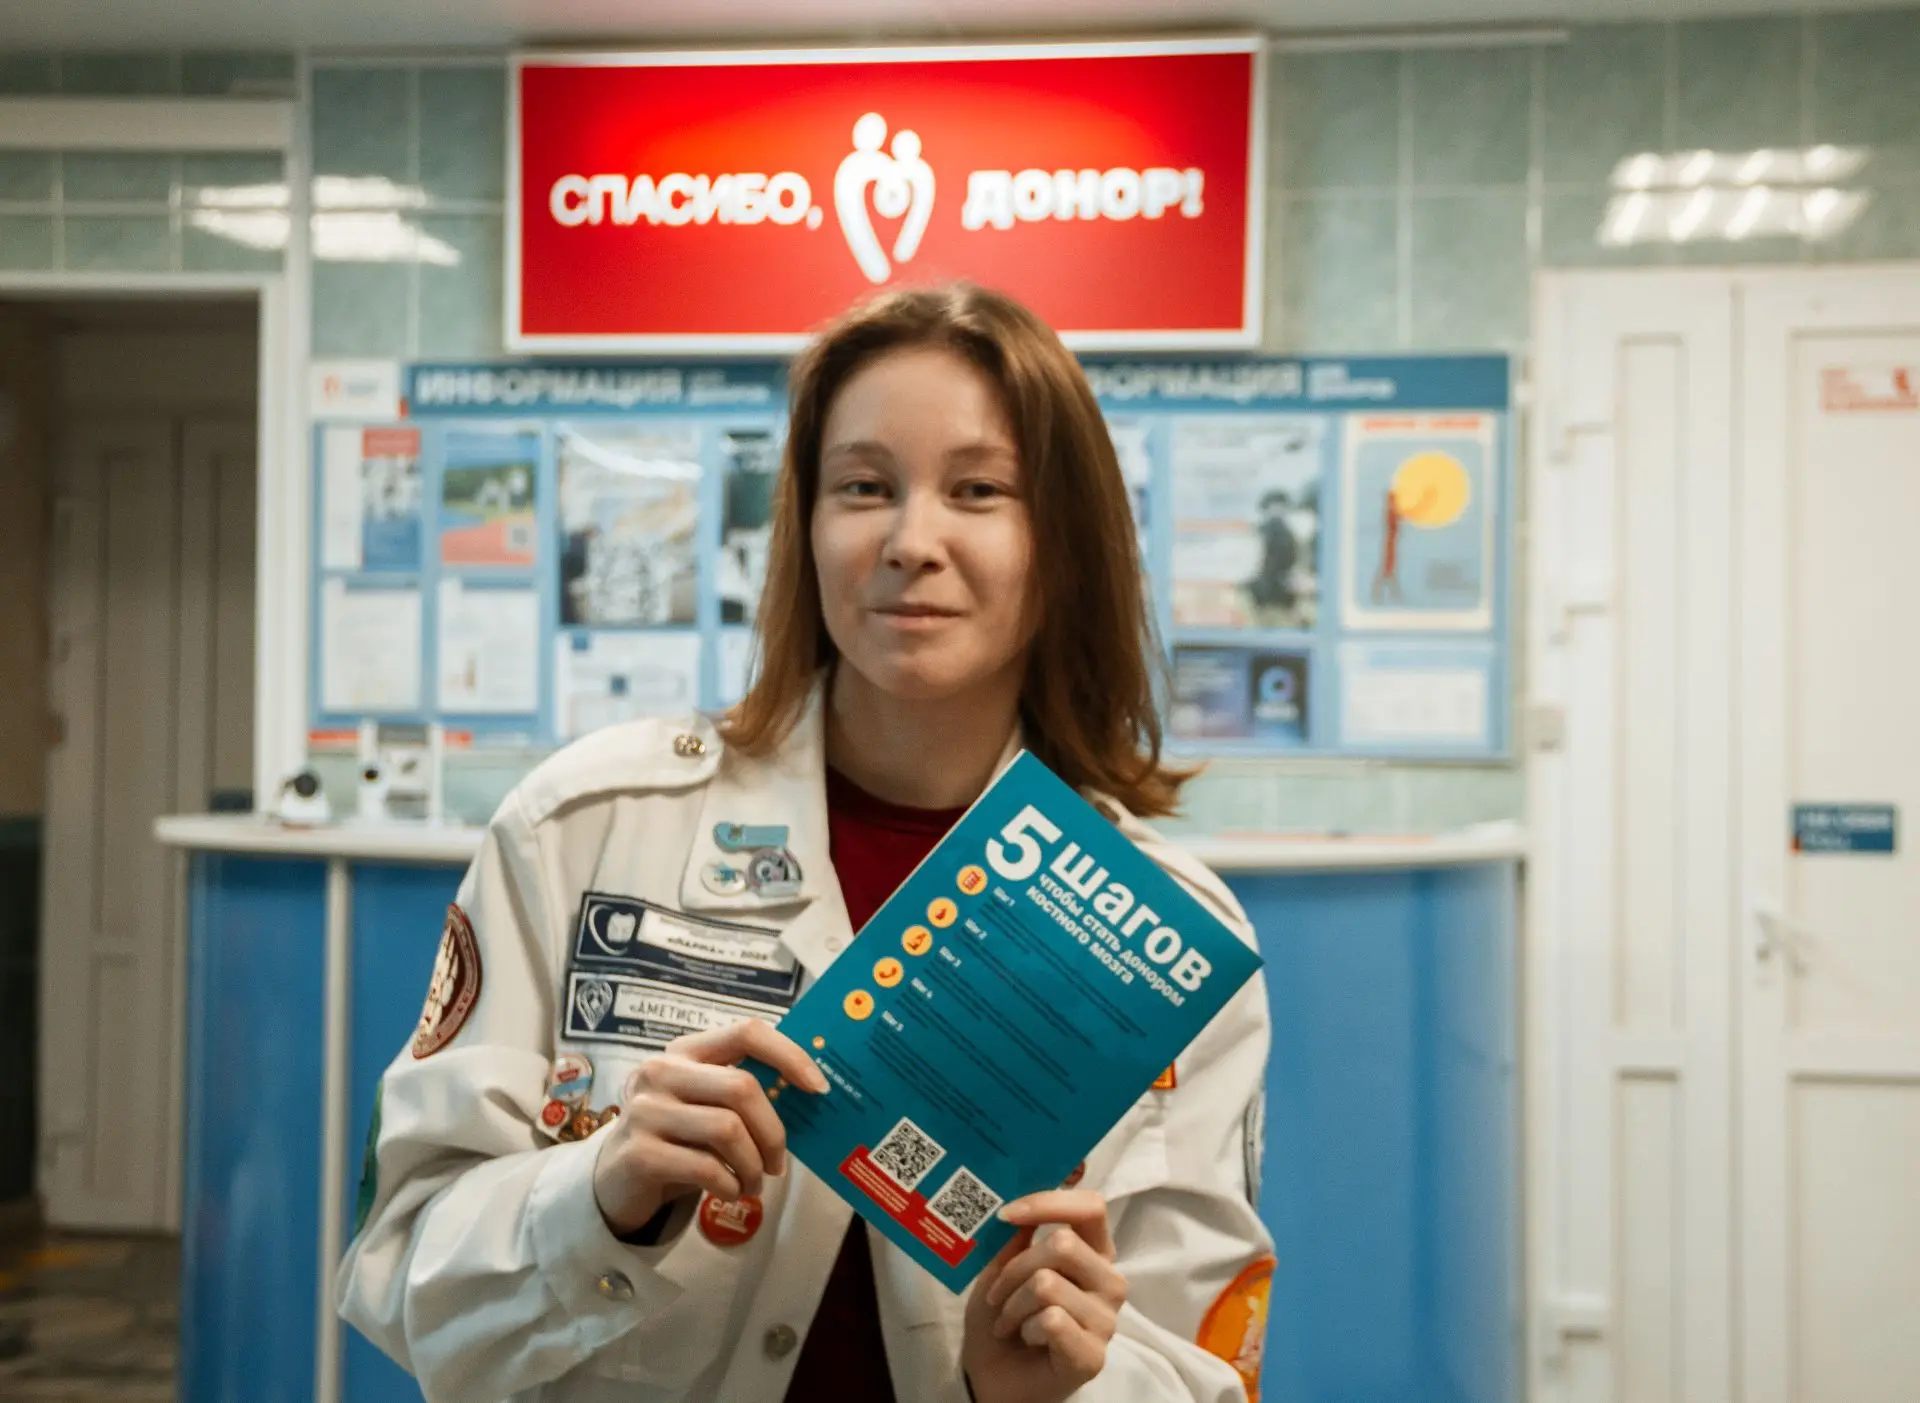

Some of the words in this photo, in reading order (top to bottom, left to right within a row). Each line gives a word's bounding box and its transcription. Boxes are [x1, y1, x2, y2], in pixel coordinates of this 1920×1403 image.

[550, 172, 824, 231] СПАСИБО,
[961, 167, 1205, 231] ДОНОР!
[985, 804, 1063, 881] 5
[1049, 842, 1213, 992] шагов
[1026, 886, 1091, 944] костного
[1089, 942, 1135, 984] мозга
[1039, 873, 1084, 917] чтобы
[1082, 914, 1121, 952] стать
[1119, 949, 1185, 1007] донором
